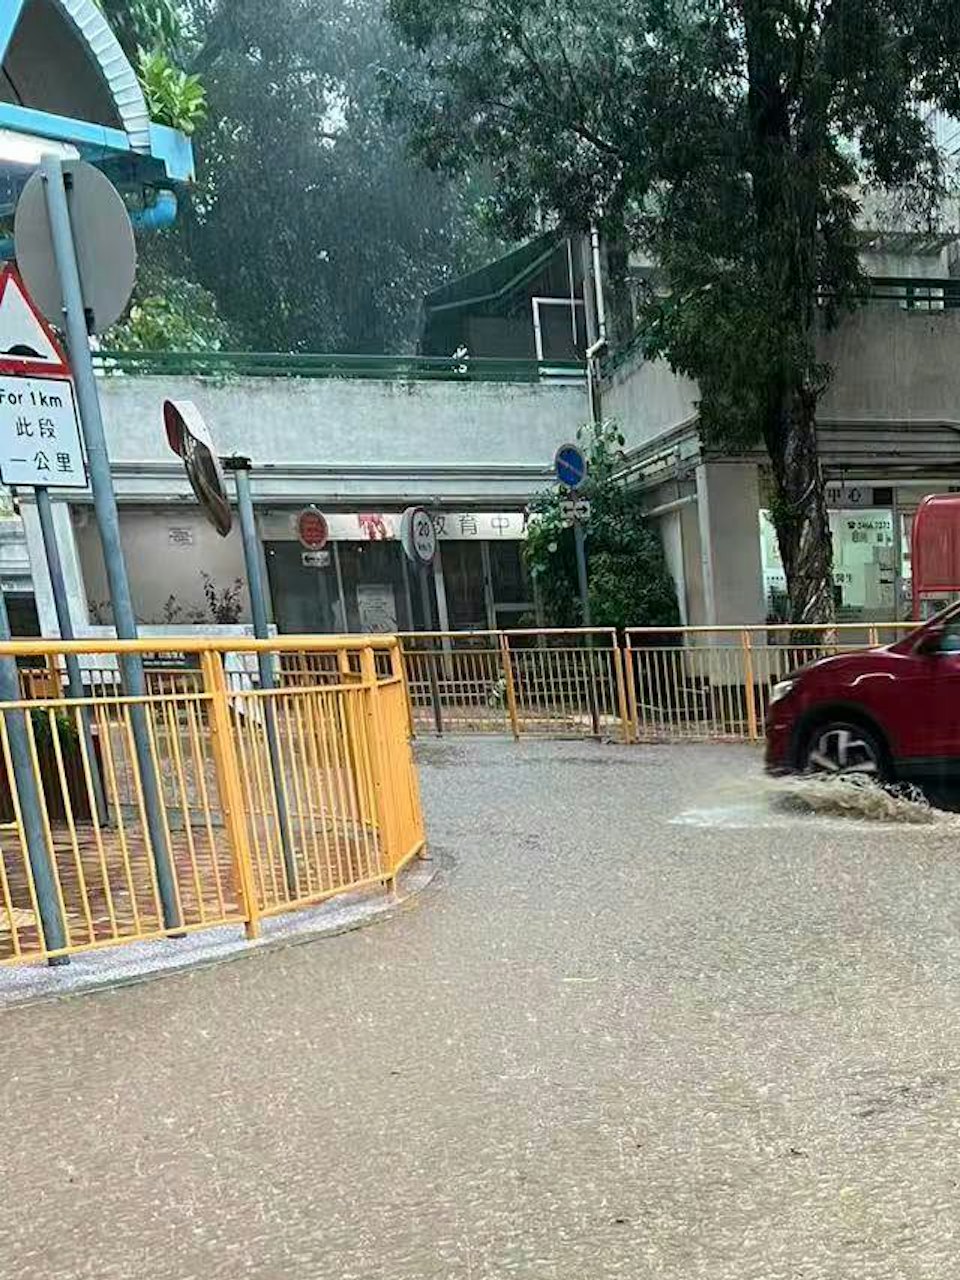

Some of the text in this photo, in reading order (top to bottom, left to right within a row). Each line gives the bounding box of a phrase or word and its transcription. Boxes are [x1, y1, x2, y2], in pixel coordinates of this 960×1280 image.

[16, 416, 57, 439] 此段
[10, 450, 75, 472] 一公里
